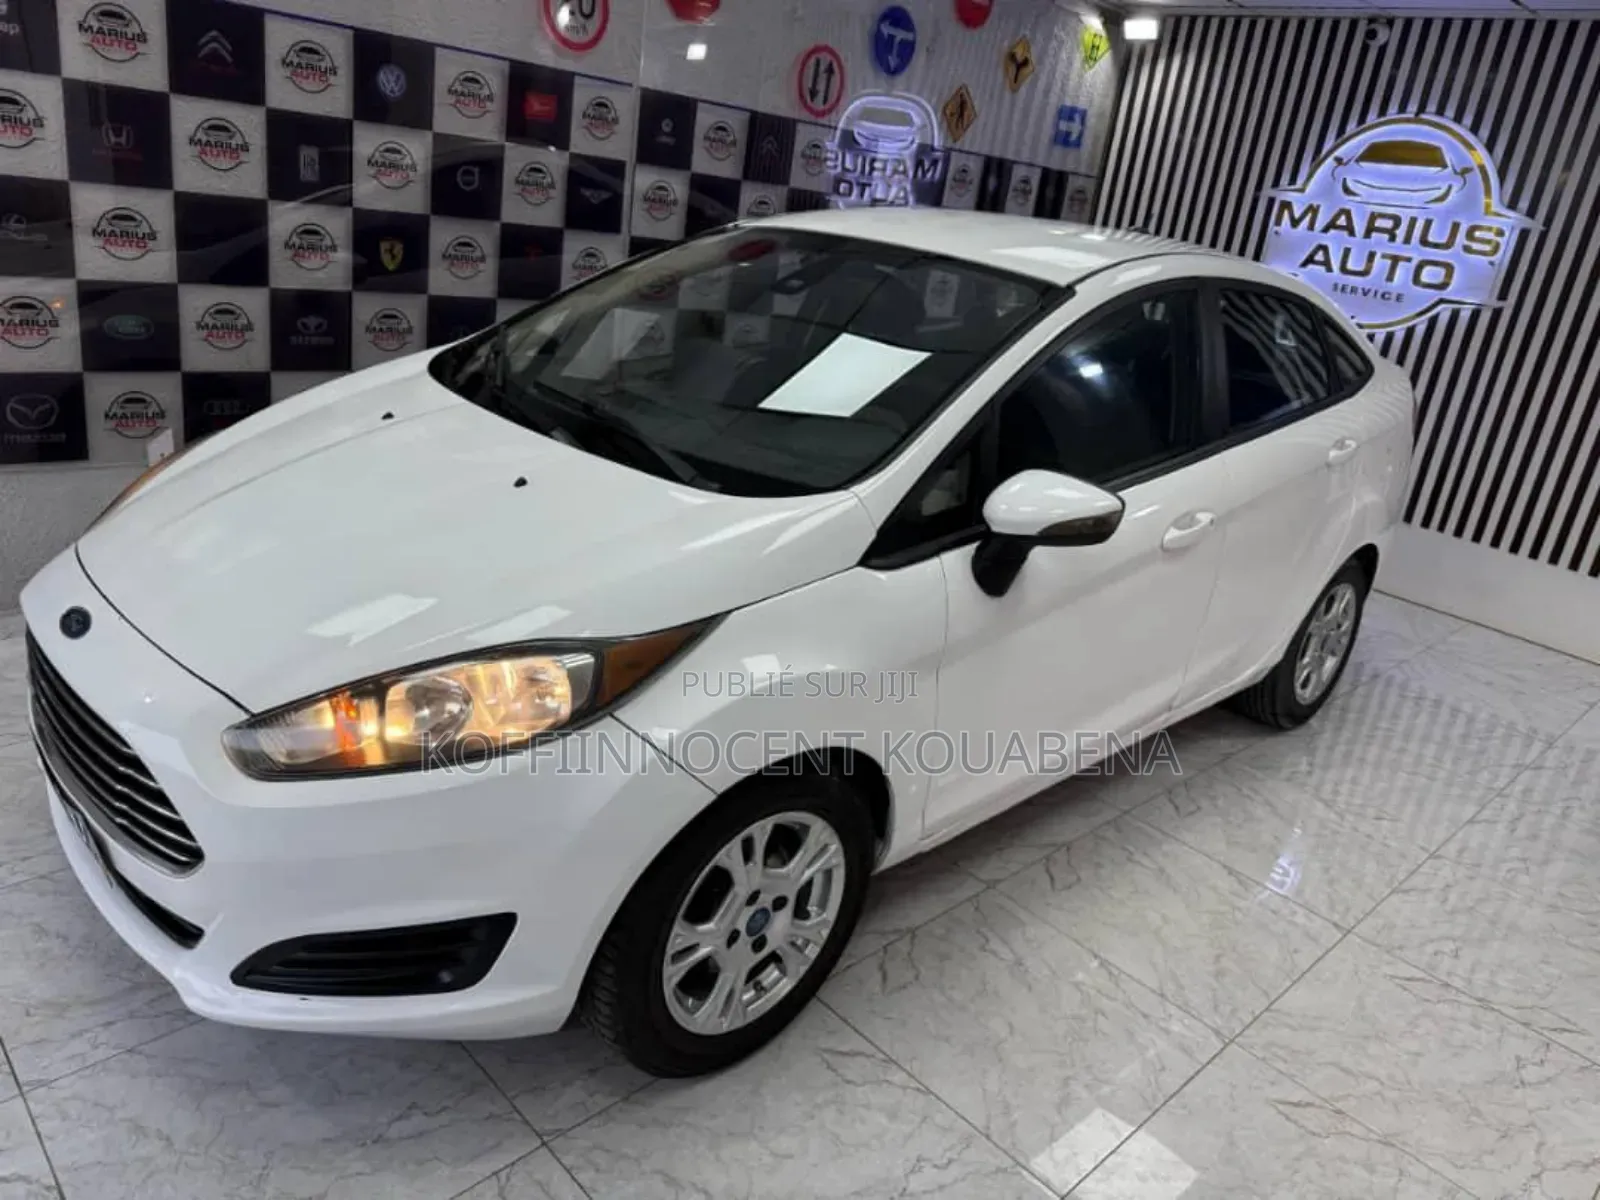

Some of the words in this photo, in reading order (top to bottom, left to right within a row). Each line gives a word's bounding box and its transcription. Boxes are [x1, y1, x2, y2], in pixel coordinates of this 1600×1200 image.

[78, 21, 148, 44] MARIUS
[90, 35, 138, 52] AUTO
[281, 58, 338, 77] MARIUS
[289, 69, 329, 84] AUTO
[0, 114, 44, 128] RIUS
[188, 136, 250, 153] MARIUS
[198, 147, 241, 161] AUTO
[367, 159, 418, 173] MARIUS
[92, 227, 157, 241] MARIUS
[1274, 199, 1506, 257] MARIUS
[102, 237, 149, 250] AUTO
[283, 241, 338, 253] MARIUS
[1299, 243, 1456, 292] AUTO
[1331, 282, 1405, 303] SERVICE
[1, 326, 50, 337] AUTO
[196, 321, 254, 332] MARIUS
[203, 330, 246, 341] AUTO
[104, 410, 166, 421] MARIUS
[114, 419, 158, 429] AUTO
